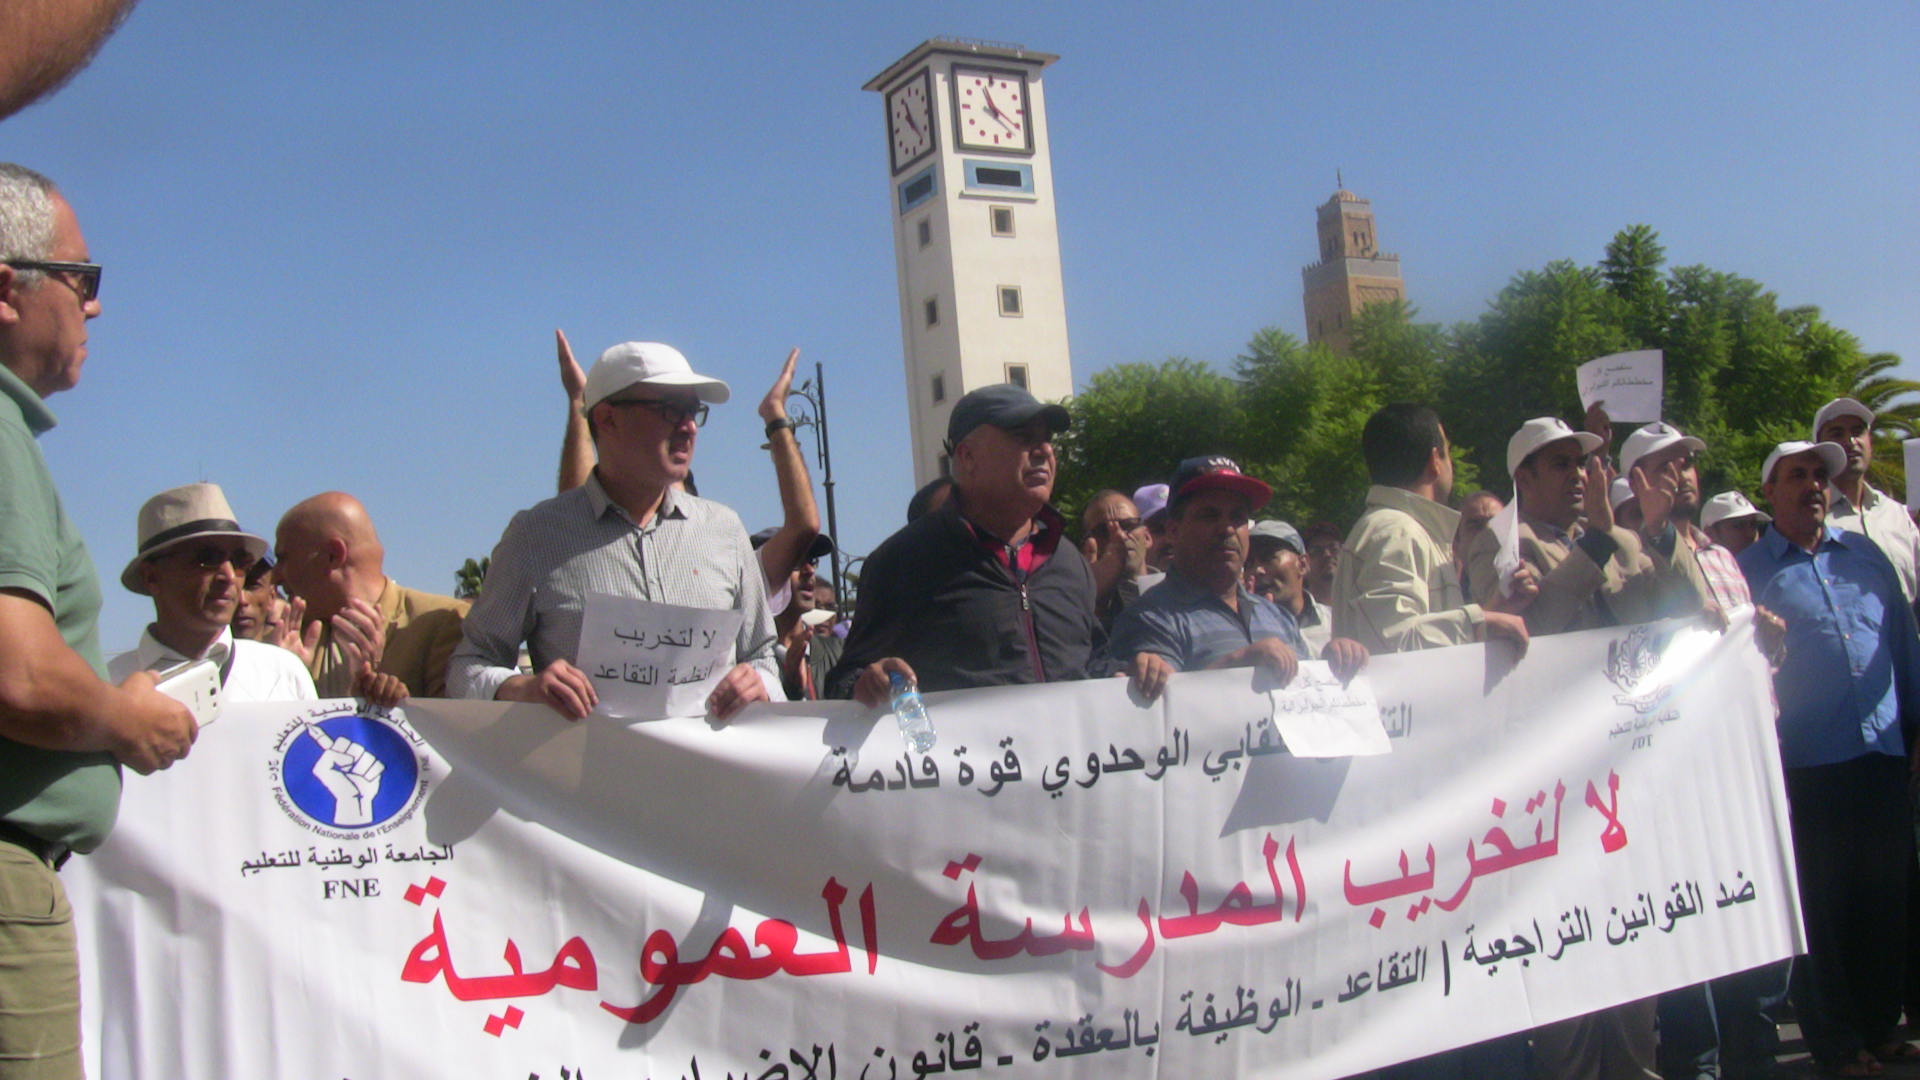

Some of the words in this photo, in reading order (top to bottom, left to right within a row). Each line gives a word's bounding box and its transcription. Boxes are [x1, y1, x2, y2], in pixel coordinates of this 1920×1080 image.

[613, 626, 694, 650] لتخريب
[702, 629, 717, 650] لا
[594, 662, 659, 686] التقاعد
[831, 745, 941, 794] قادمة
[953, 735, 1022, 798] قوة
[1042, 728, 1189, 800] الوحدوي
[272, 786, 311, 830] Fédération
[312, 825, 361, 841] Nationale
[362, 830, 376, 840] de
[377, 779, 429, 835] l'Enseignement
[1585, 768, 1628, 854] لا
[240, 850, 301, 877] للتعليم
[307, 847, 378, 869] الوطنية
[384, 843, 455, 866] الجامعة
[1343, 776, 1564, 929] لتخريب
[323, 878, 381, 900] FNE
[929, 832, 1306, 979] المدرسة
[1605, 880, 1704, 946] القوانين
[1715, 871, 1756, 909] ضد
[401, 876, 879, 1038] العمومية
[1463, 906, 1593, 977] التراجعية
[1337, 946, 1427, 1004] التقاعد
[1032, 1008, 1160, 1062] بالعقدة
[1175, 978, 1301, 1045] الوظيفة
[859, 1021, 983, 1080] قانون
